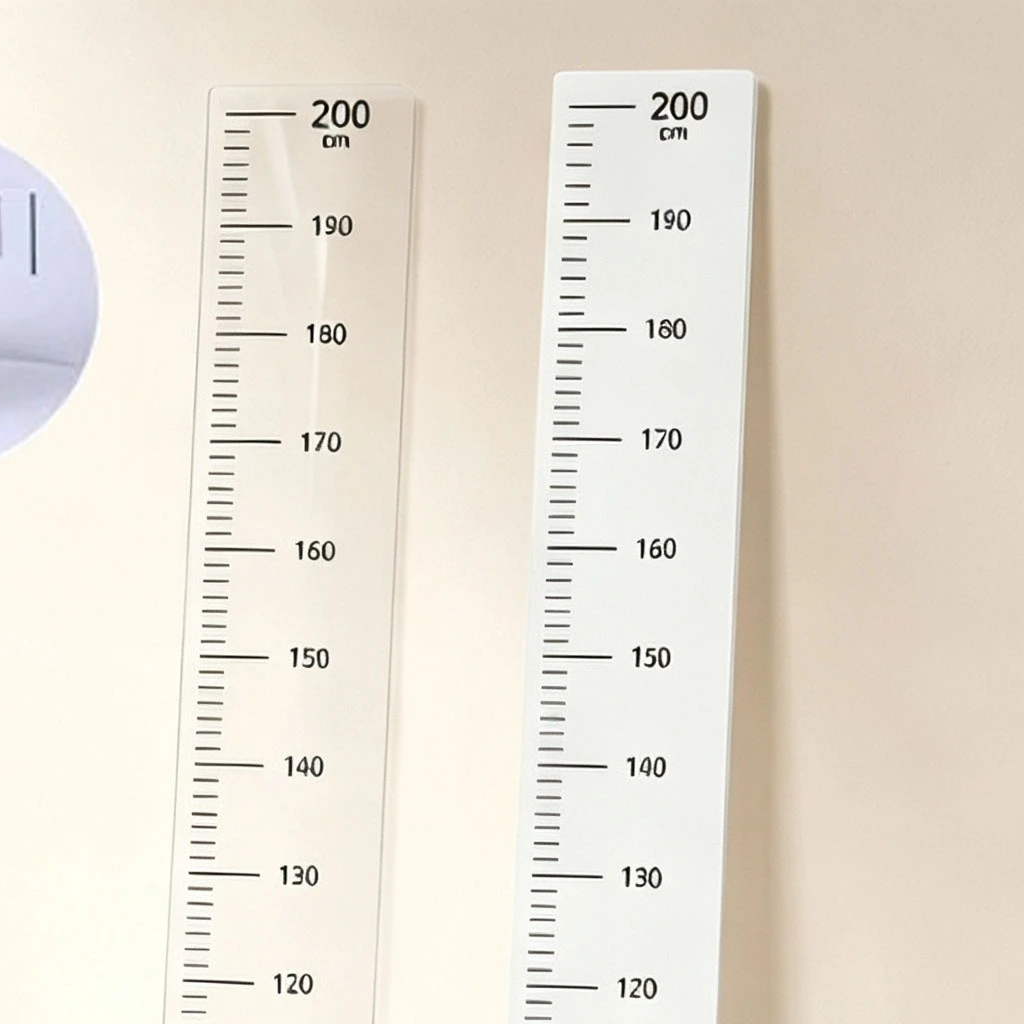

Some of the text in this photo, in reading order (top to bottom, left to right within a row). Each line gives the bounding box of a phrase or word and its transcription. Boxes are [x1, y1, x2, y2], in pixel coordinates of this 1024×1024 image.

[311, 99, 371, 129] 200
[650, 90, 709, 121] 200
[312, 214, 353, 237] 190
[651, 208, 692, 232] 190
[306, 322, 347, 346] 180
[301, 431, 342, 453] 170
[641, 427, 683, 451] 170
[295, 540, 336, 562] 160
[636, 537, 677, 560] 160
[290, 647, 330, 669] 150
[631, 645, 671, 669] 150
[284, 755, 324, 778] 140
[626, 756, 667, 778] 140
[279, 864, 319, 887] 130
[621, 865, 663, 889] 130
[273, 973, 314, 995] 120
[617, 977, 658, 1000] 120
